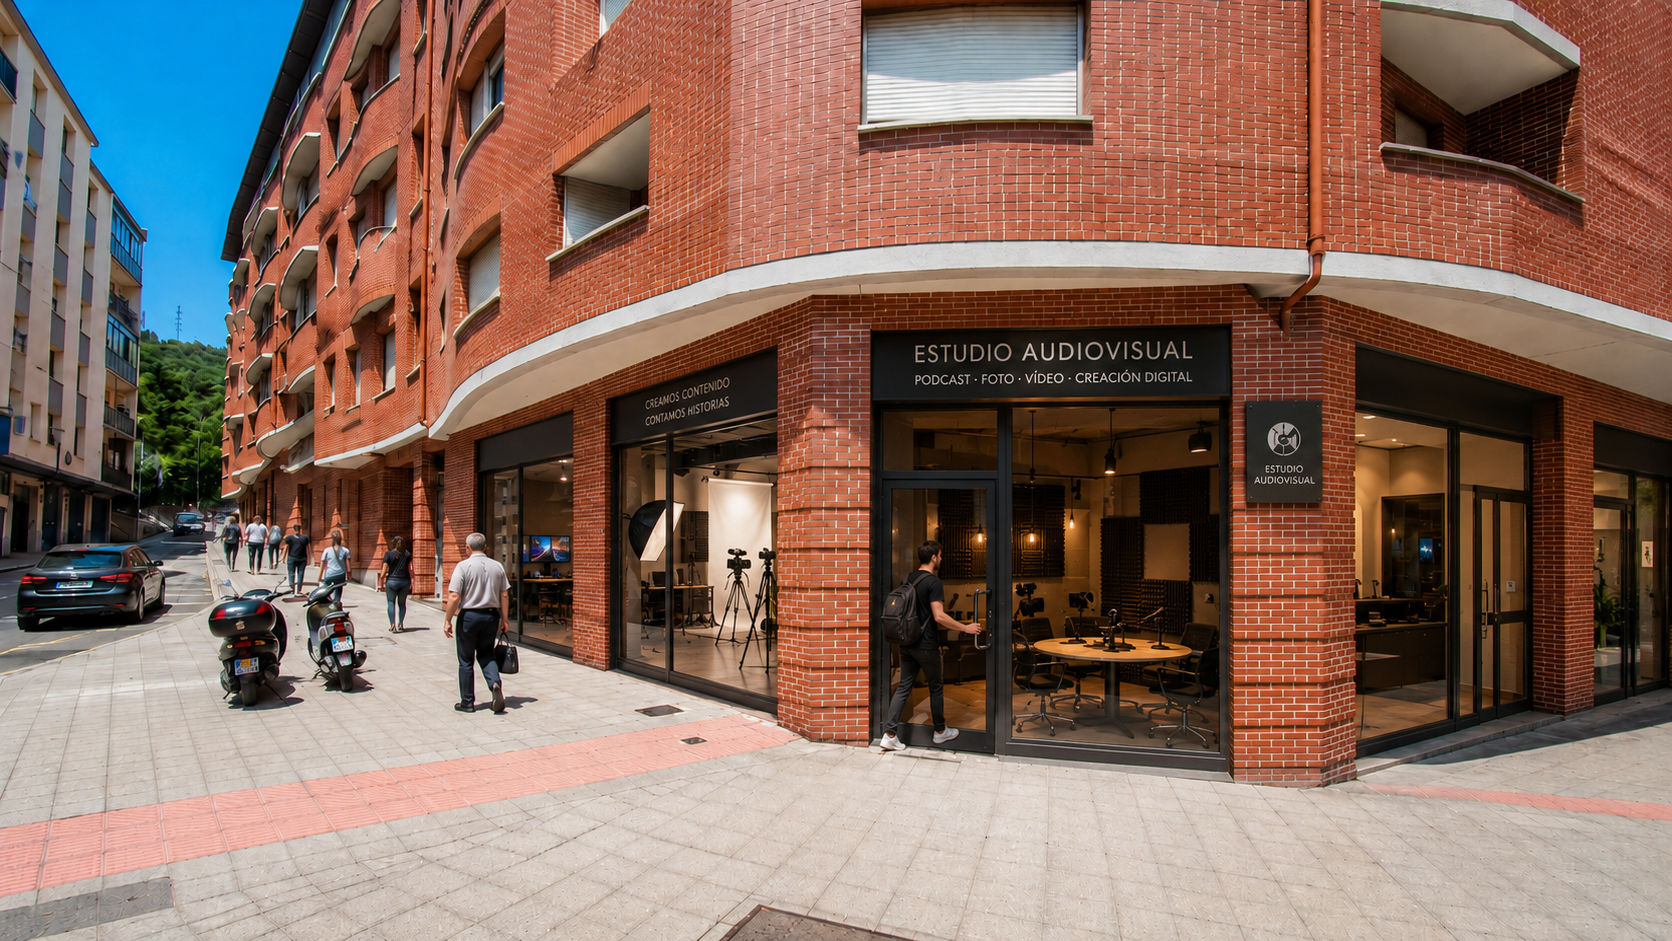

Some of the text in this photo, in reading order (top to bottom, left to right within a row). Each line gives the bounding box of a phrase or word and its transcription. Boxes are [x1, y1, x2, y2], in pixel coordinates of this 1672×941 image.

[914, 340, 1193, 363] ESTUDIO AUDIOVISUAL
[914, 369, 1193, 386] PODCAST FOTO VÍDEO CREACIÓN DIGITAL
[645, 377, 730, 410] CREAMOS CONTENIDO
[645, 396, 730, 426] CONTAMOS HISTORIAS
[1264, 464, 1304, 474] ESTUDIO
[1253, 475, 1316, 485] AUDIOVISUAL
